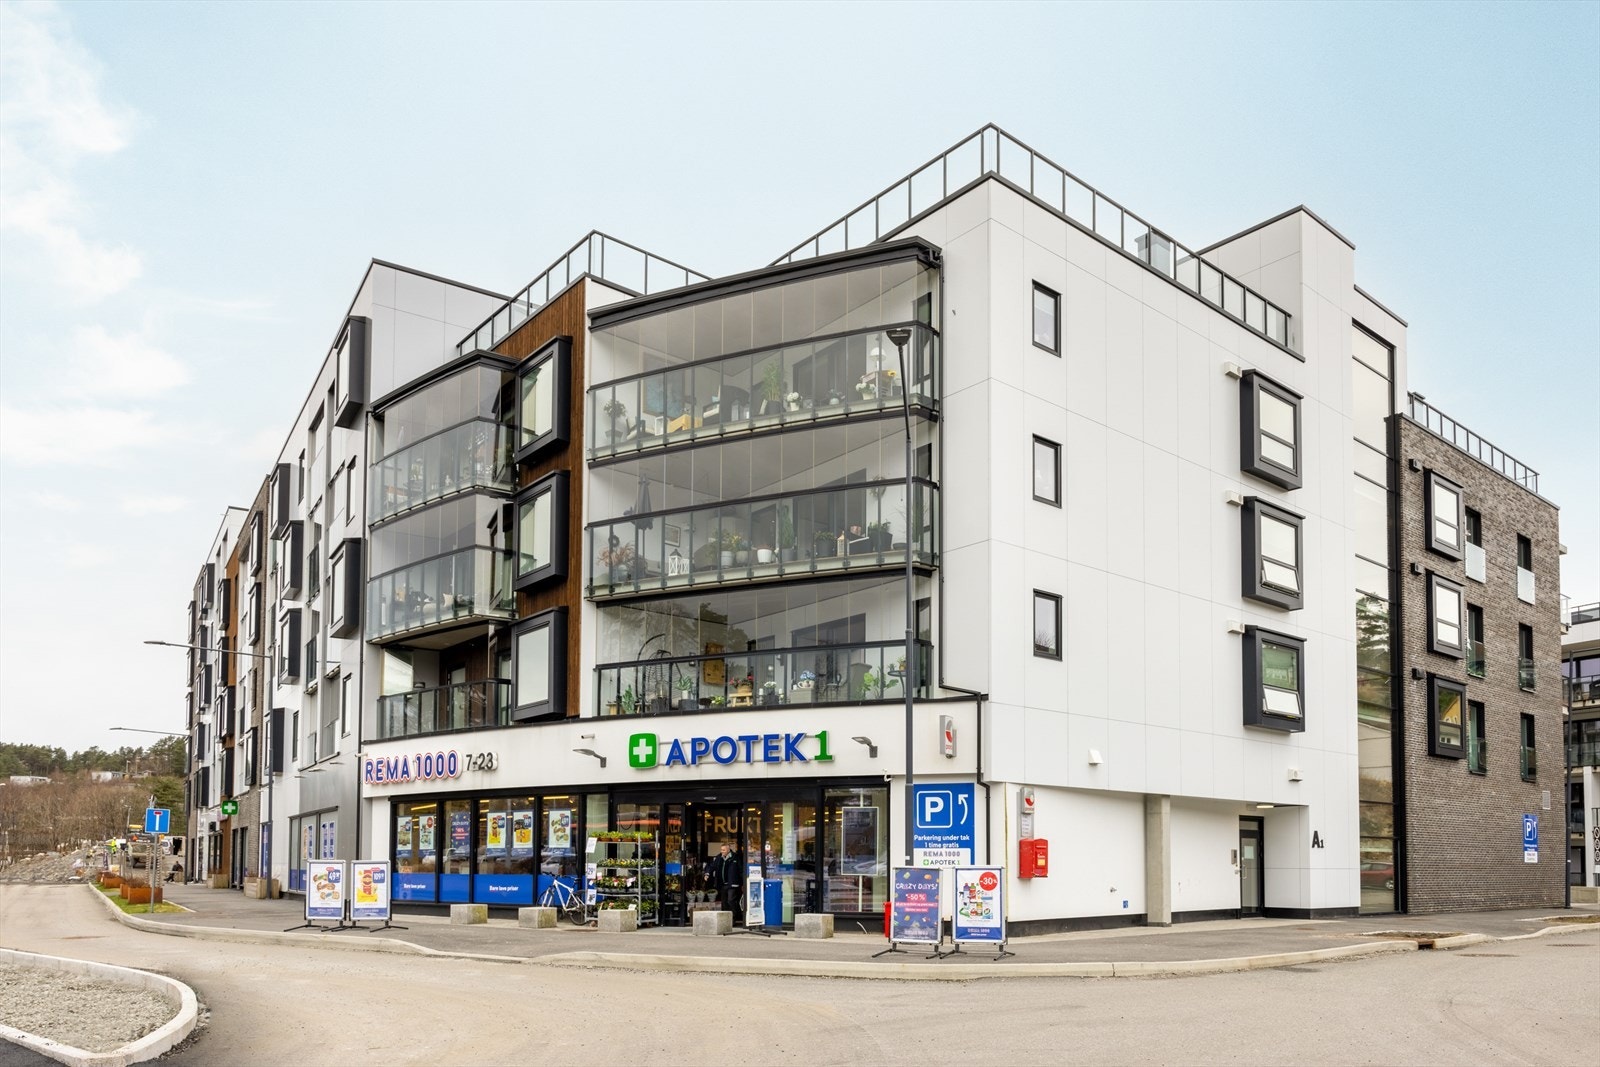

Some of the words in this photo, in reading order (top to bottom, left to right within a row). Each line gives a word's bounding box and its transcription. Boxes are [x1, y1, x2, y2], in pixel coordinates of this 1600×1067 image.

[665, 732, 808, 766] APOTEK
[814, 730, 833, 762] 1
[365, 755, 411, 784] REMA
[415, 750, 459, 780] 1000
[466, 751, 495, 772] 7-23
[925, 796, 944, 822] P
[704, 815, 762, 833] FRUKT
[914, 834, 941, 842] Parkering
[895, 882, 917, 890] CRAZY
